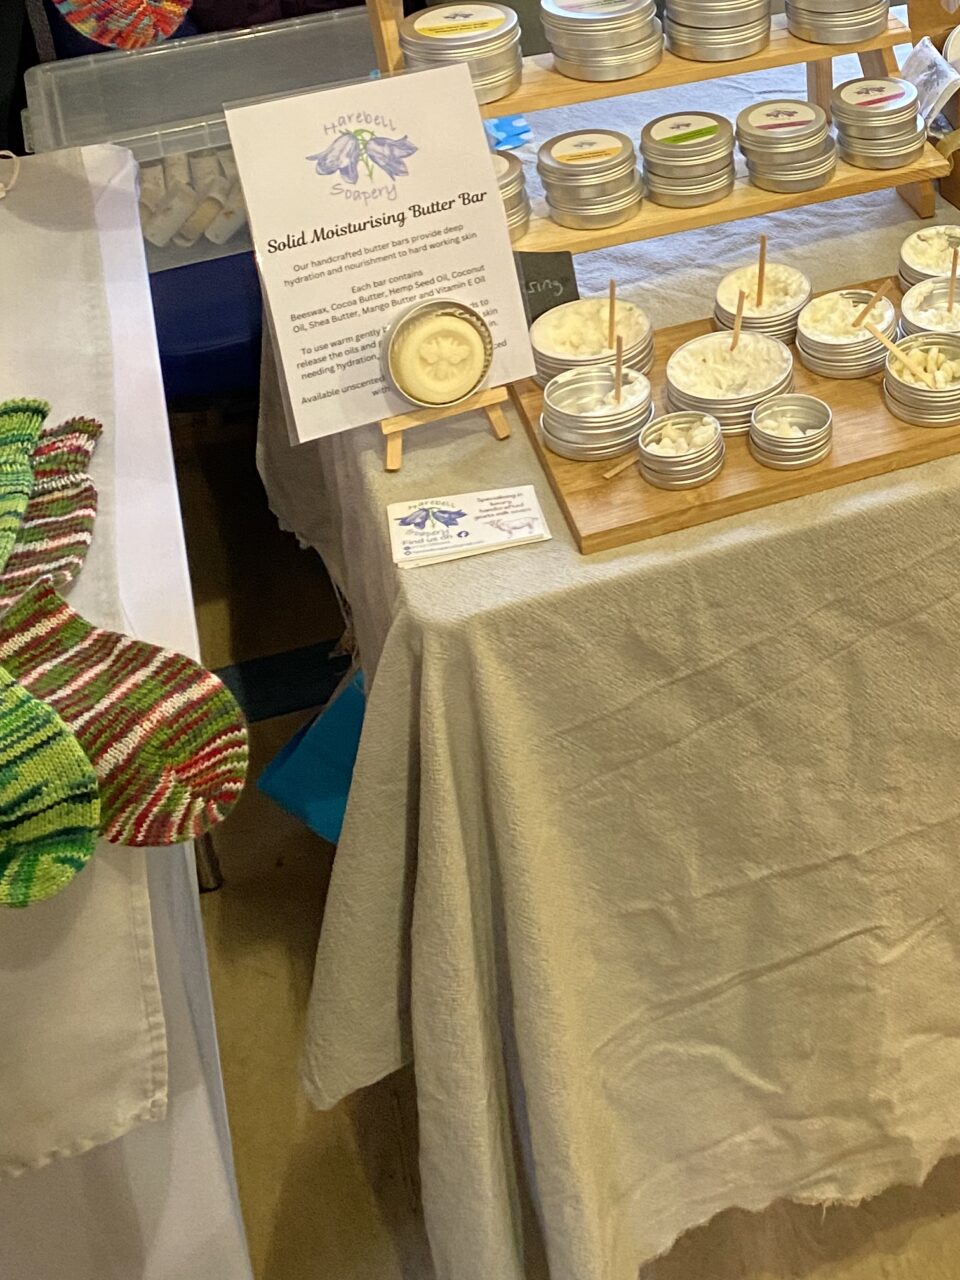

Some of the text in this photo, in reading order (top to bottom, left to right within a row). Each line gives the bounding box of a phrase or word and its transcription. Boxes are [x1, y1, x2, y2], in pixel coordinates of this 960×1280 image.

[324, 112, 396, 135] Harebell
[330, 183, 397, 206] Soapery
[267, 192, 487, 254] Solid Moisturising Butter Bar
[284, 232, 478, 287] hydration and nourishment to hard working skin
[293, 224, 464, 272] Our handcrafted butter bars provide deep
[290, 265, 485, 321] Beeswax, Cocoa Butter, Hemp Seed Oil, Coconut
[351, 270, 424, 293] Each bar contains
[293, 324, 308, 333] Oil,
[309, 318, 330, 328] Shea
[331, 310, 361, 322] Butter,
[362, 302, 390, 315] Mango
[391, 294, 416, 306] Butter
[419, 290, 434, 299] and
[436, 281, 466, 294] Vitamin
[474, 276, 486, 284] Oil
[482, 308, 498, 317] skin
[296, 356, 326, 368] release
[329, 352, 343, 360] the
[344, 347, 359, 355] oils
[360, 341, 376, 351] and
[301, 347, 312, 355] To
[314, 343, 329, 352] use
[330, 336, 354, 348] warm
[355, 328, 381, 342] gently
[301, 354, 380, 379] needing hydration,
[302, 374, 385, 404] Available unscented
